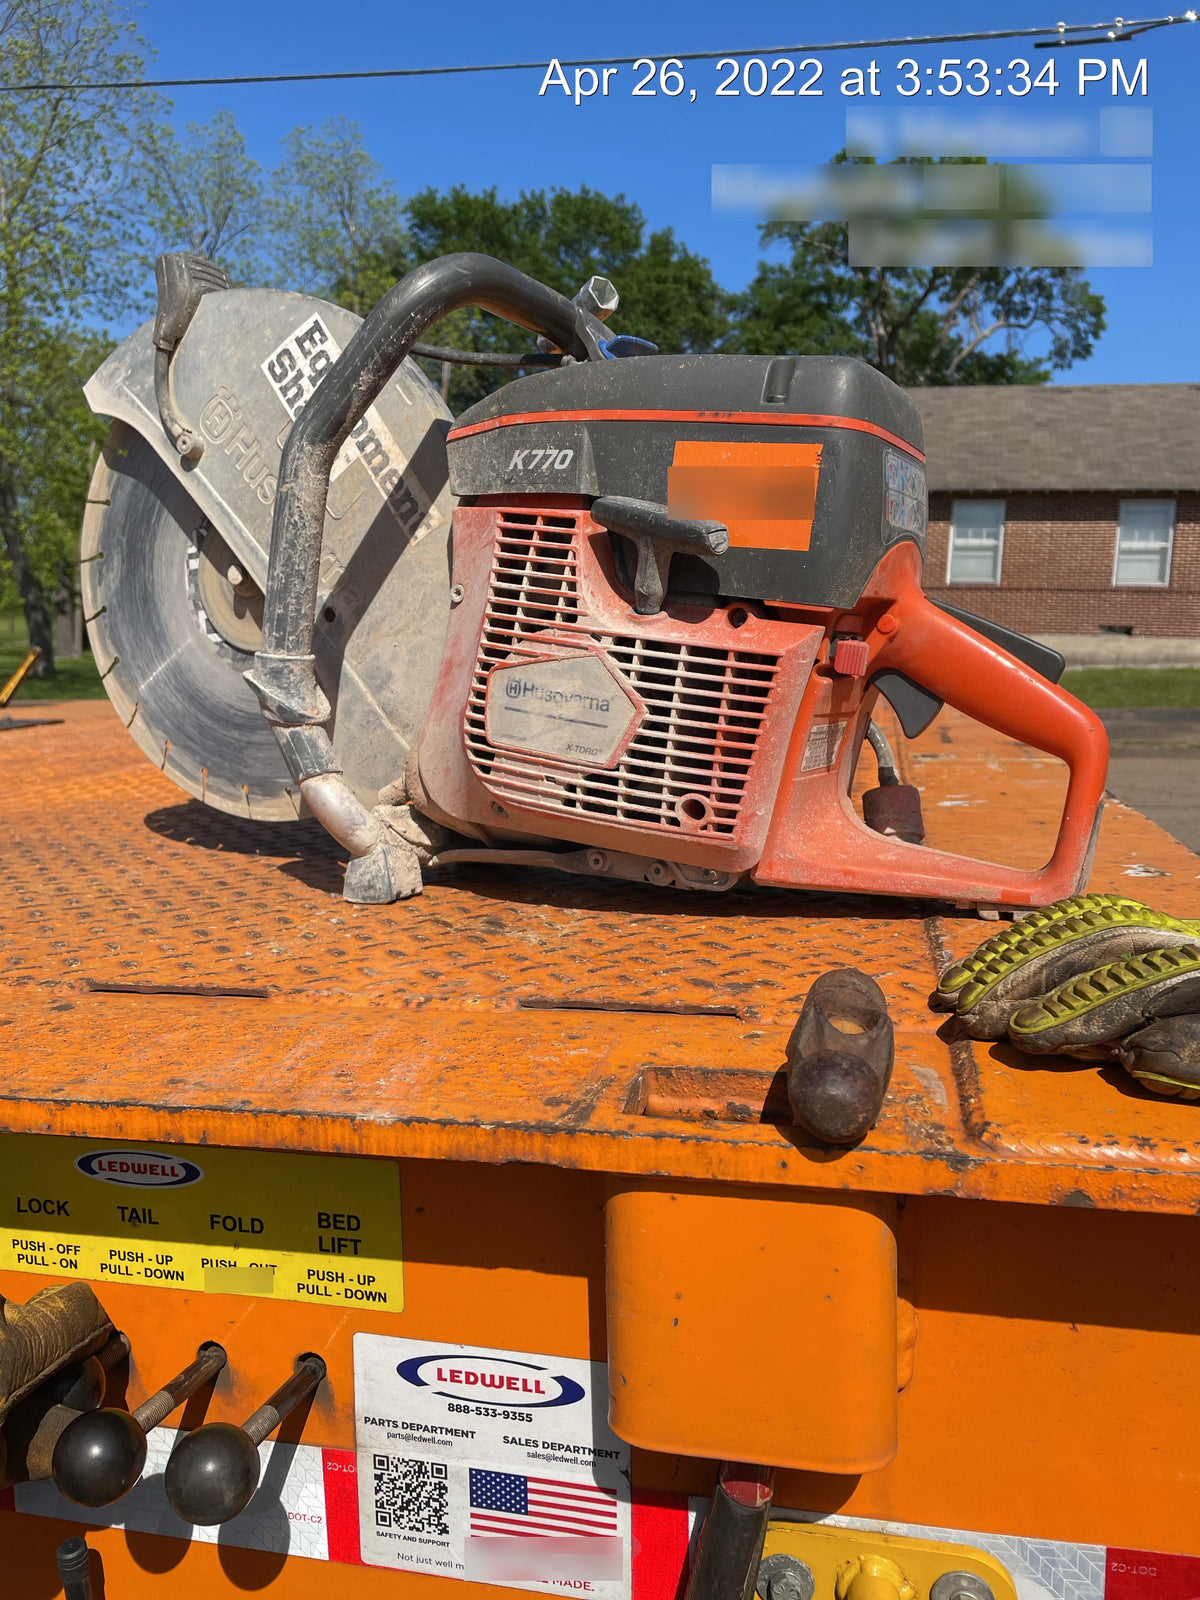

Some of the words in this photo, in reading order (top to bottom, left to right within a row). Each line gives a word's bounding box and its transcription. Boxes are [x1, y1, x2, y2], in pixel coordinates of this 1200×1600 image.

[508, 449, 574, 470] K770
[97, 1159, 180, 1179] LEDWELL
[16, 1197, 70, 1217] LOCK
[117, 1206, 160, 1226] TAIL
[209, 1214, 265, 1235] FOLD
[317, 1212, 361, 1232] BED
[12, 1239, 46, 1252] PUSH
[56, 1243, 81, 1256] OFF
[318, 1236, 362, 1256] LIFT
[17, 1253, 49, 1267] PULL
[59, 1258, 78, 1270] ON
[109, 1249, 144, 1263] PUSH
[155, 1254, 174, 1266] UP
[100, 1263, 133, 1276] PULL
[144, 1267, 185, 1282] DOWN
[307, 1269, 345, 1284] PUSH
[356, 1274, 376, 1287] UP
[296, 1283, 332, 1297] PULL
[344, 1288, 388, 1304] DOWN
[436, 1367, 546, 1395] LEDWELL
[447, 1402, 533, 1423] 888-533-9355
[363, 1416, 399, 1429] PARTS
[401, 1421, 476, 1440] DEPARTMENT
[386, 1431, 453, 1447] parts@ledwell.com
[502, 1435, 539, 1448] SALES
[542, 1441, 621, 1460] DEPARTMENT
[526, 1450, 597, 1468] sales@ledwell.com
[287, 1511, 323, 1525] DOT-C2
[376, 1531, 402, 1541] SAFETY
[402, 1535, 417, 1543] AND
[418, 1537, 450, 1548] SUPPORT
[397, 1552, 414, 1562] Not
[416, 1556, 432, 1566] just
[435, 1559, 453, 1569] well
